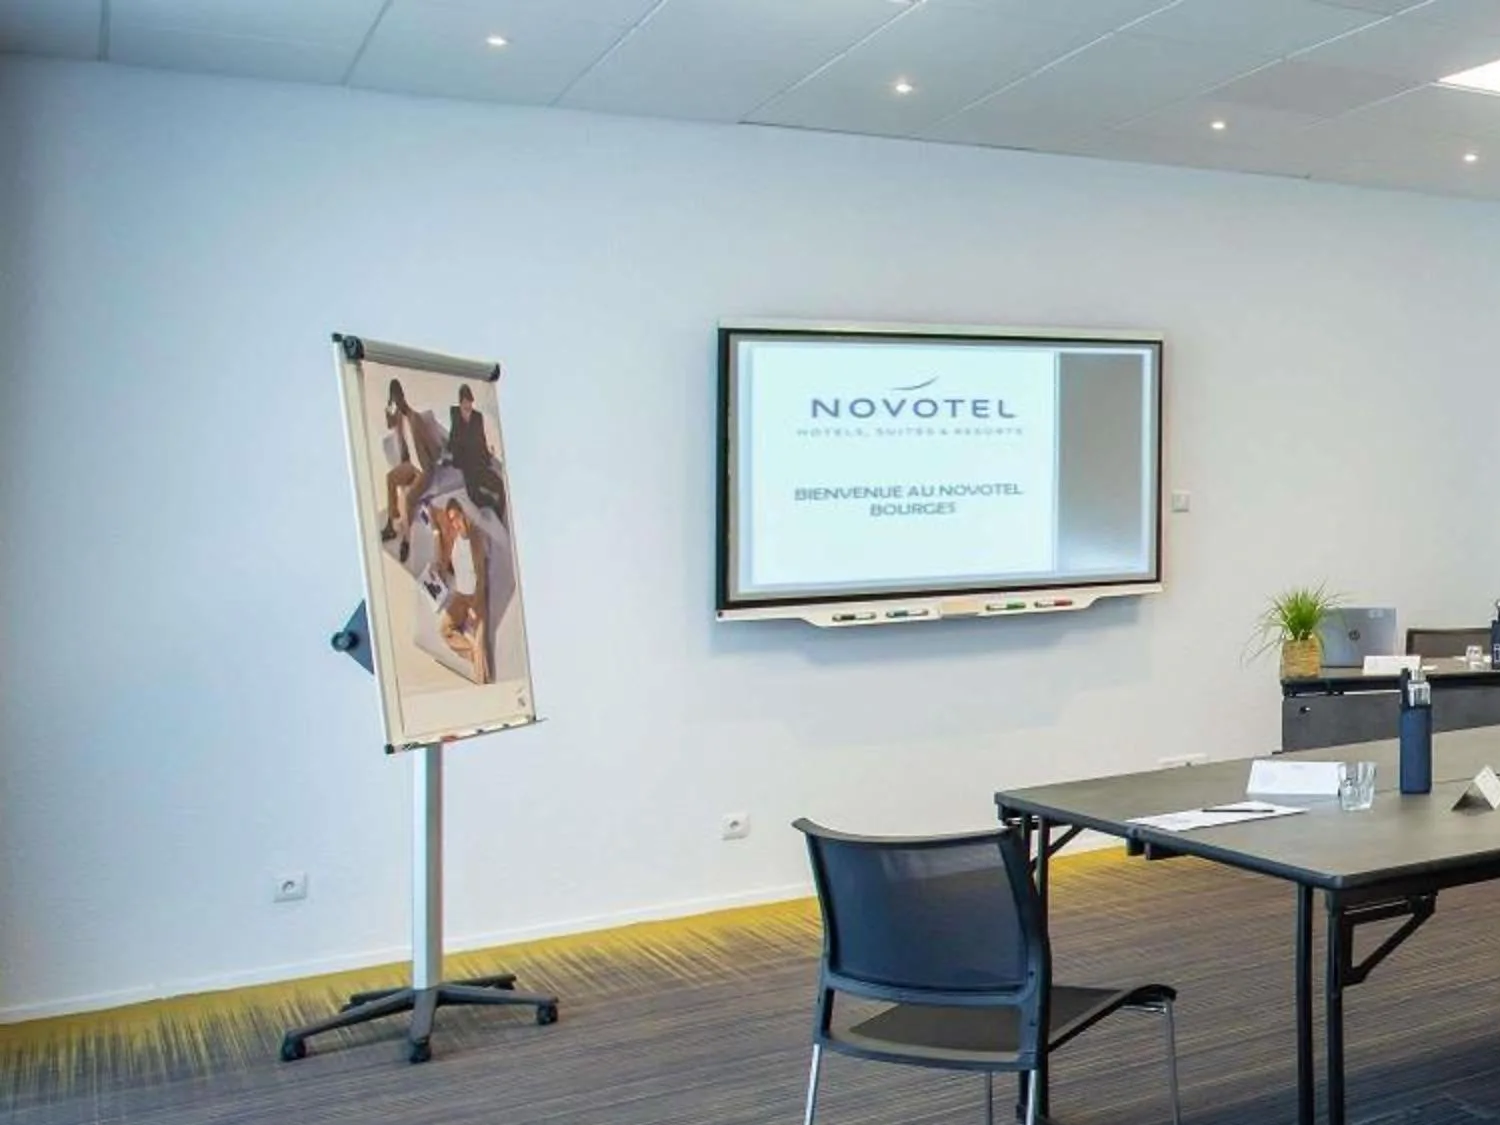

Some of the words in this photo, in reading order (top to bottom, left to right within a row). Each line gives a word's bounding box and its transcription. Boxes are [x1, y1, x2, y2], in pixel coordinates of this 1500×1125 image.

[811, 398, 1017, 419] NOVOTEL
[794, 486, 901, 501] BIENVENUE
[906, 485, 935, 497] AU
[939, 483, 1023, 497] NOVOTEL
[869, 502, 957, 517] BOURGES
